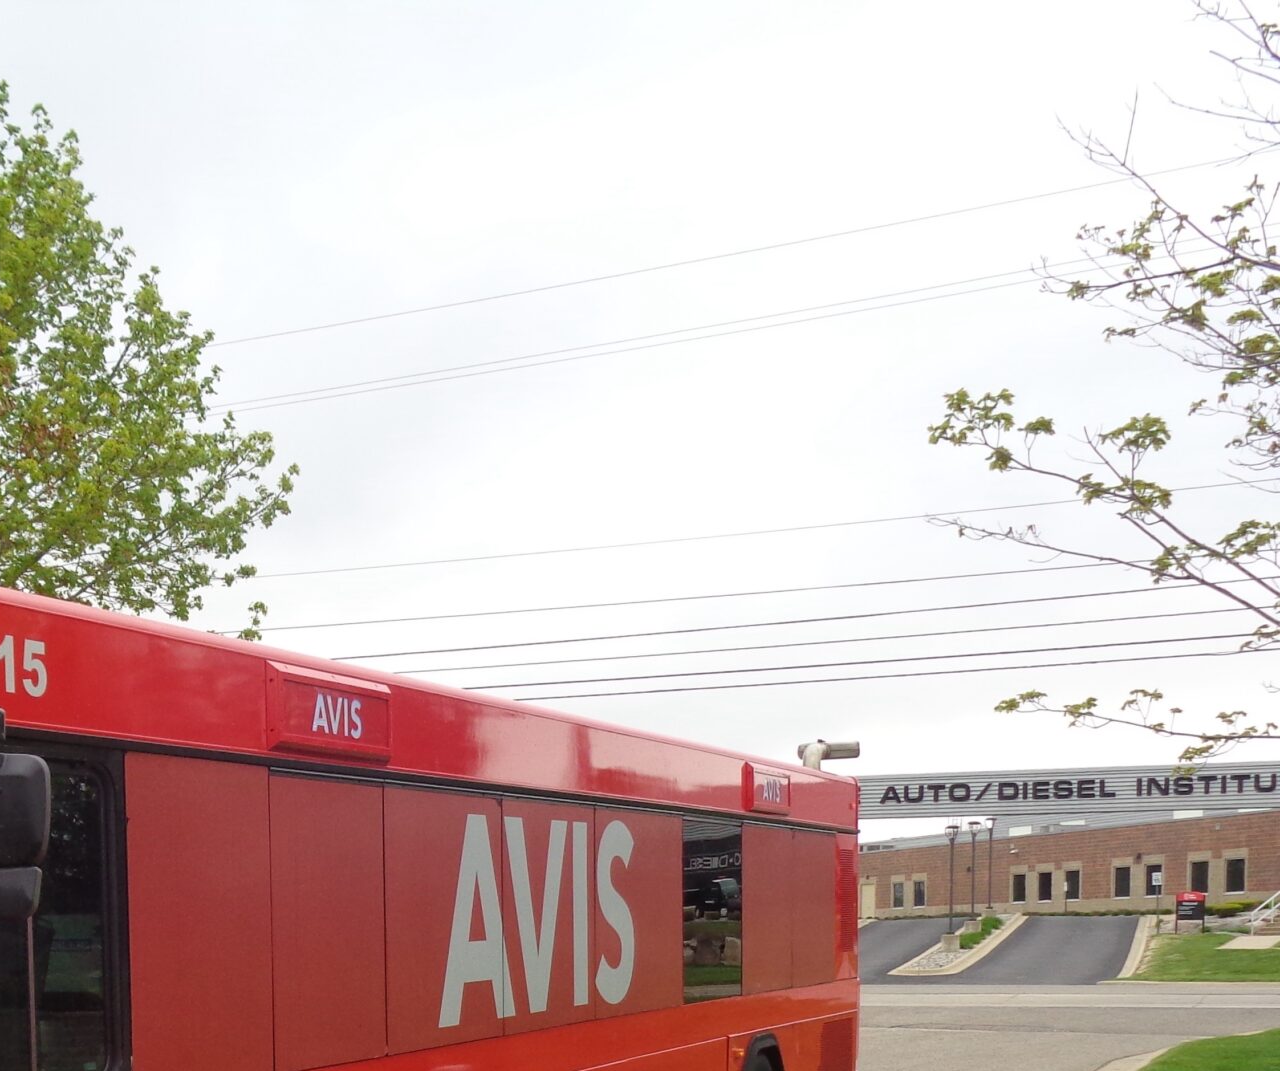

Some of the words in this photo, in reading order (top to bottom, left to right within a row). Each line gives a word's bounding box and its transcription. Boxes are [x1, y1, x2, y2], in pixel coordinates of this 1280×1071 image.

[312, 692, 362, 740] AVIS
[763, 779, 781, 804] AVIS
[879, 779, 1117, 805] AUTO/DIESEL
[1135, 773, 1278, 797] INSTITU
[439, 813, 635, 1028] AVIS
